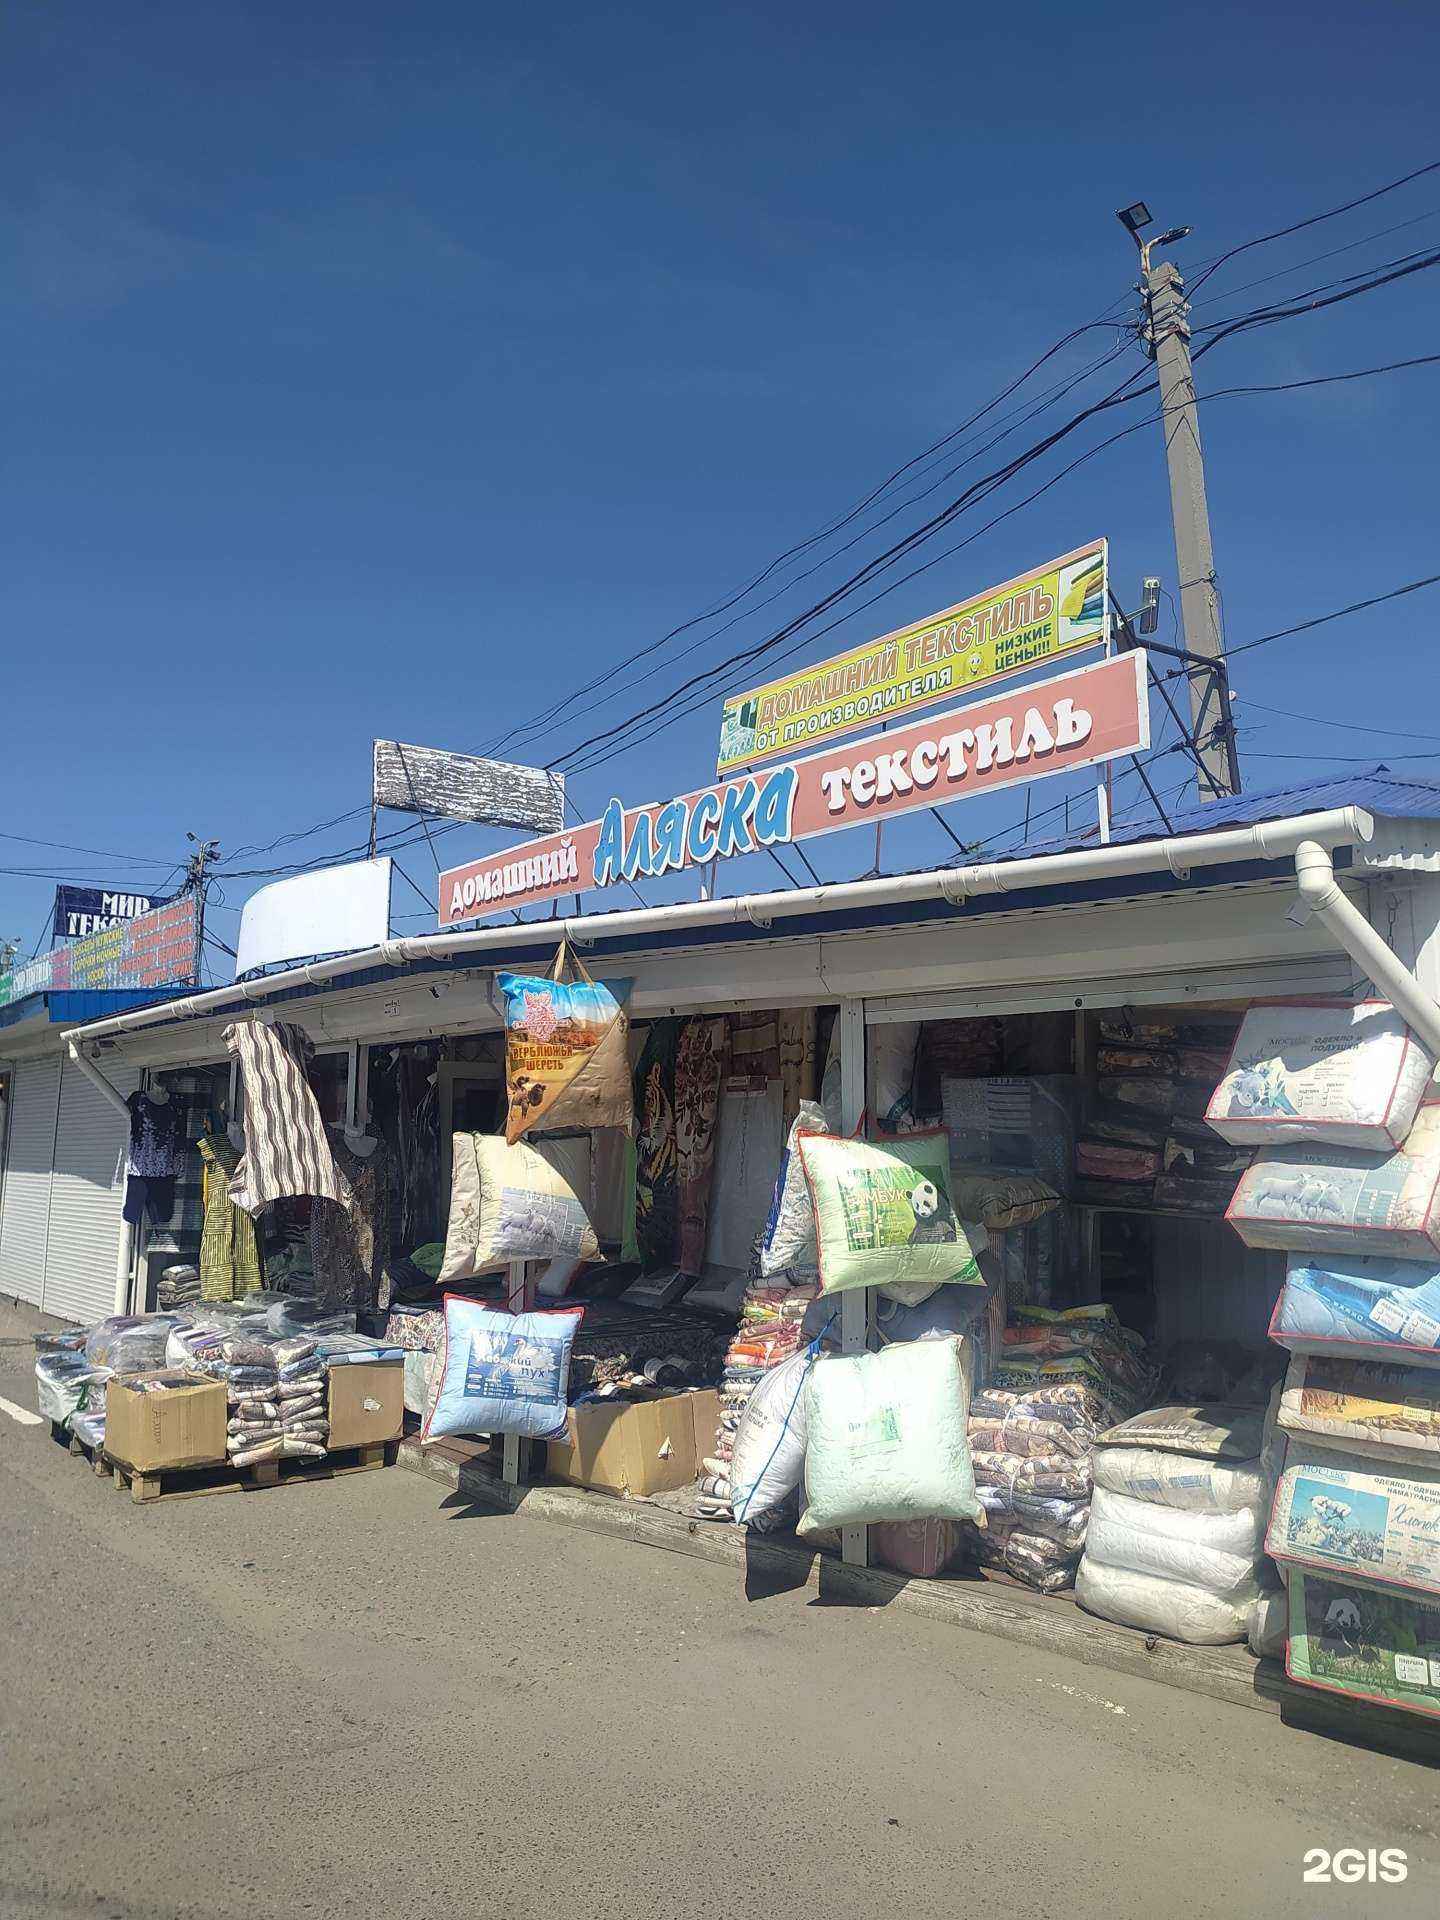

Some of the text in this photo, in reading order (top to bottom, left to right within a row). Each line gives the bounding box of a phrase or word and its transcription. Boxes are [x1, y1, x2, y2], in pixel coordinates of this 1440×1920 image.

[995, 623, 1052, 655] НИЗКИЕ
[757, 584, 1055, 732] ДОМАШНИЙ ТЕКСТИЛЬ
[995, 640, 1050, 671] ЦЕНЫ!!!
[755, 665, 952, 750] ОТ ПРОИЗВОДИТЕЛЯ
[102, 892, 150, 918] МИР
[512, 1045, 573, 1060] ВЕРБЛЮЖЬЯ
[525, 1059, 564, 1071] ШЕРСТЬ
